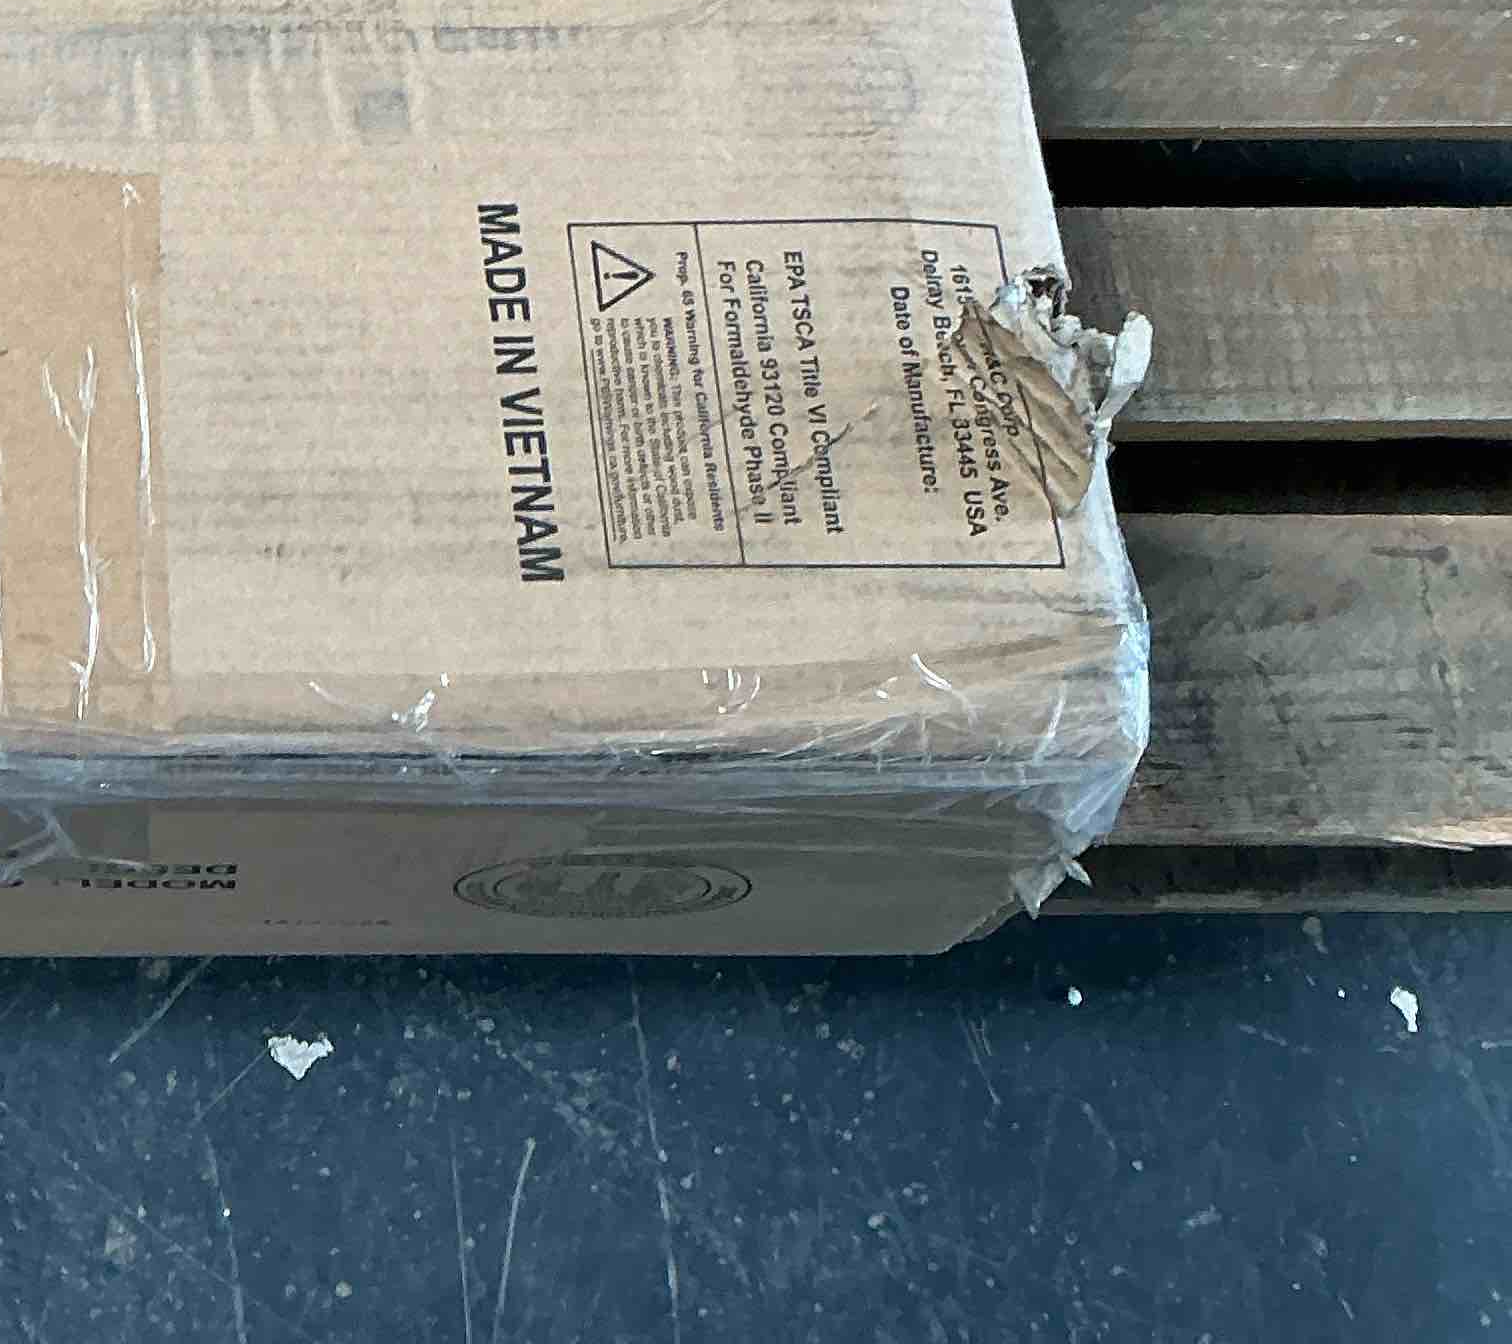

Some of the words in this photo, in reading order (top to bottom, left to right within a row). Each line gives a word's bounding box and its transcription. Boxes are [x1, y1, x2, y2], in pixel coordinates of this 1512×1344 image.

[477, 204, 531, 322] MADE
[676, 252, 692, 286] Prop.
[718, 261, 737, 292] For
[784, 251, 807, 290] EPA
[920, 249, 945, 309] Delray
[745, 260, 774, 352] California
[791, 294, 815, 350] TSCA
[891, 287, 911, 330] Date
[494, 331, 536, 374] IN
[662, 318, 680, 381] WARNING:
[684, 309, 704, 364] Warning
[899, 337, 919, 356] of
[692, 369, 705, 388] for
[723, 298, 758, 440] Formaldehyde
[758, 359, 784, 416] 93120
[799, 357, 822, 397] Title
[695, 392, 717, 458] California
[808, 404, 827, 424] VI
[902, 363, 938, 494] Manufacture:
[945, 389, 964, 413] FL
[743, 446, 767, 505] Phase
[770, 423, 802, 526] Compliant
[952, 419, 978, 479] 33445
[969, 376, 1003, 471] Congress
[988, 476, 1009, 522] Ave.
[501, 386, 564, 583] VIETNAM
[704, 462, 726, 532] Residents
[811, 430, 845, 534] Compliant
[963, 490, 987, 537] USA
